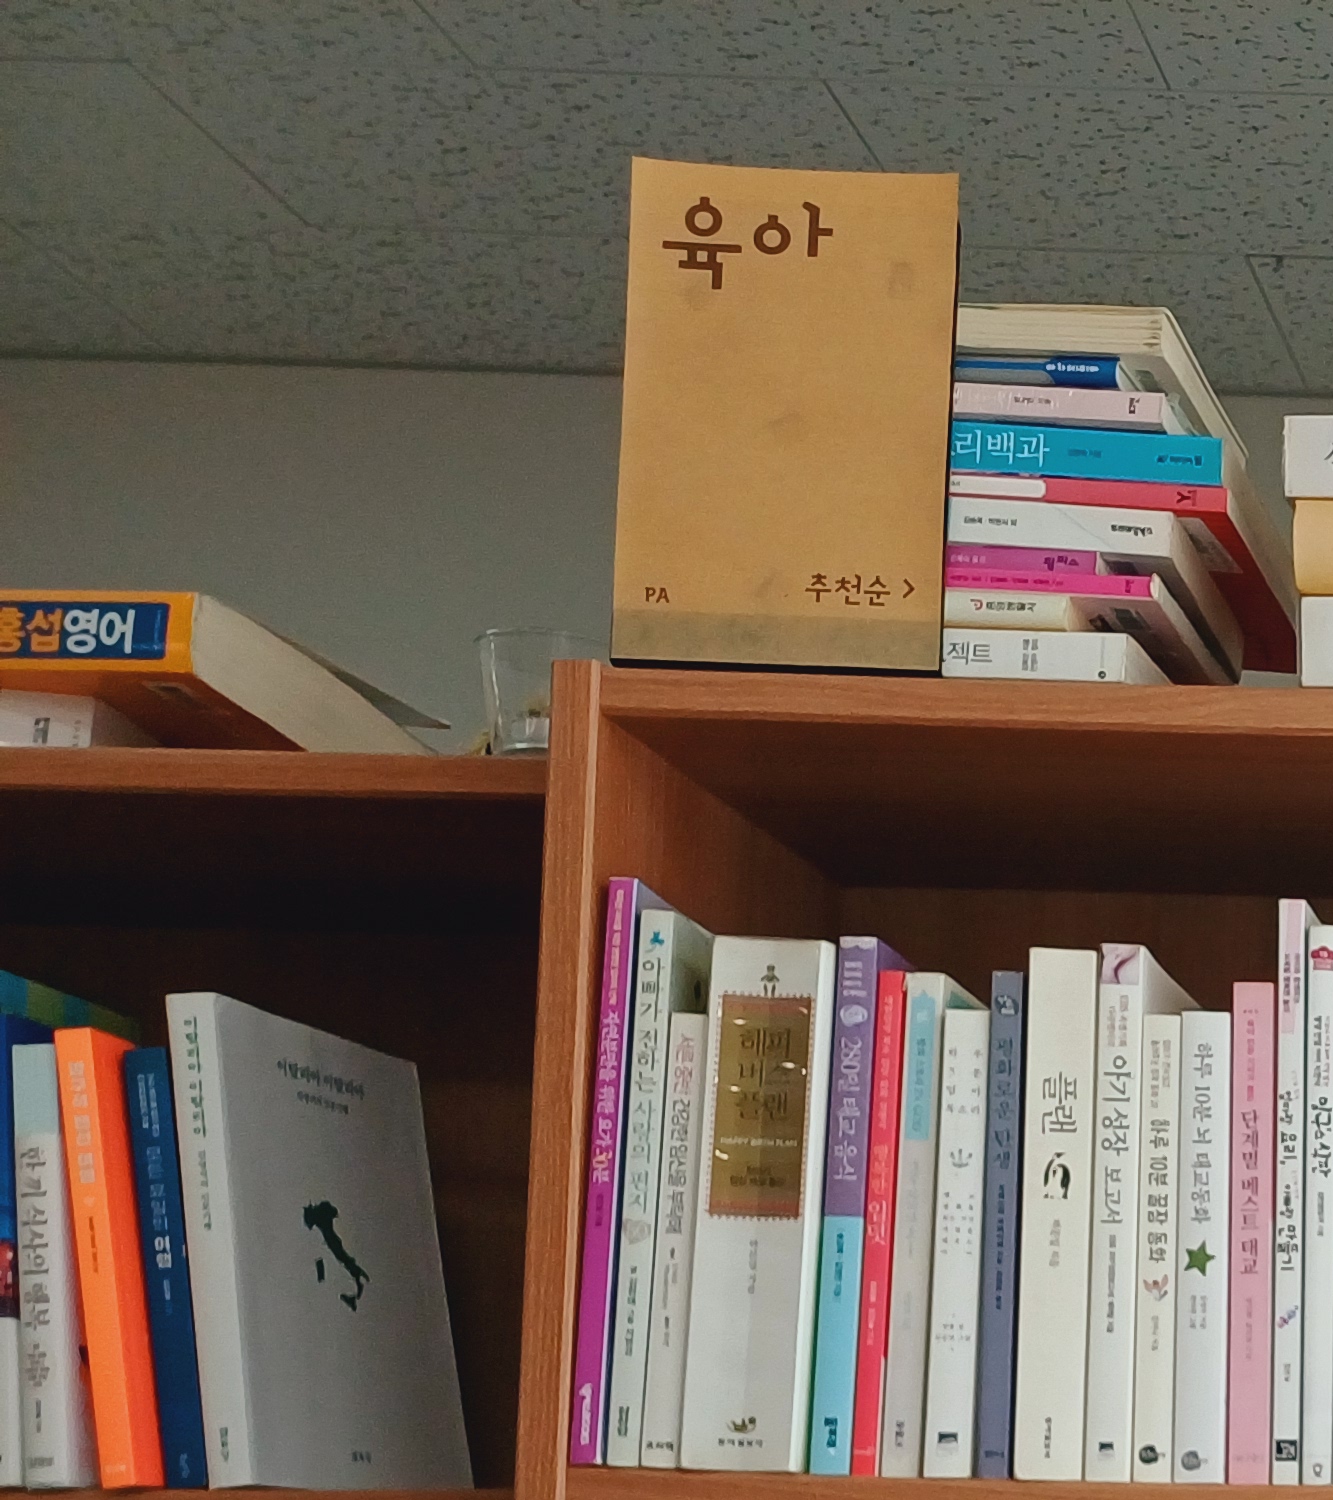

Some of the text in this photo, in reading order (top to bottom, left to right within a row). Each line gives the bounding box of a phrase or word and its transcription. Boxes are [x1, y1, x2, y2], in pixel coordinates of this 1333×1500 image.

[662, 197, 833, 290] 육아
[951, 429, 1050, 468] 리백과
[644, 586, 670, 604] PA
[805, 572, 891, 607] 추천순
[943, 638, 993, 666] 젝트
[1042, 1071, 1078, 1135] 플랜
[1101, 1055, 1130, 1224] 아기 성장 보고서
